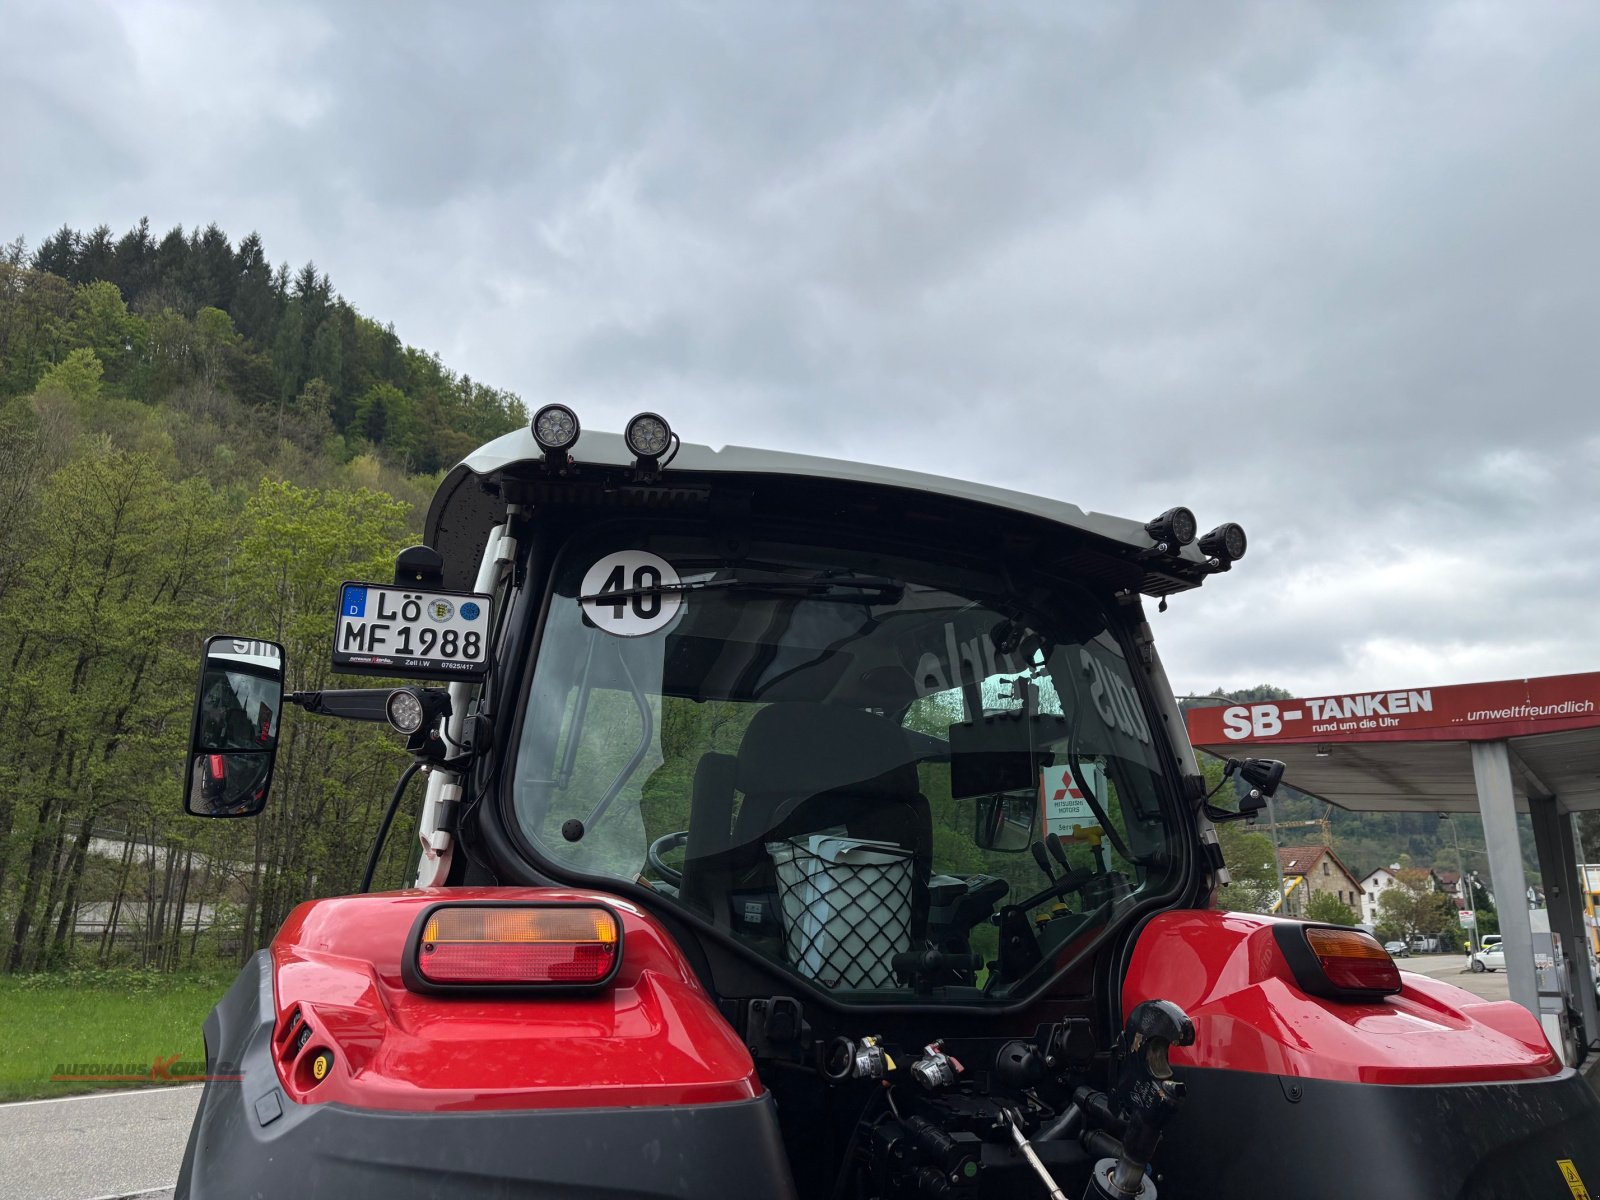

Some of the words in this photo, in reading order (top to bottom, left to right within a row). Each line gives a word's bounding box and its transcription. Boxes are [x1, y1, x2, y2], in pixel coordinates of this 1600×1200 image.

[595, 565, 661, 620] 40
[350, 606, 358, 615] D
[376, 592, 423, 622] LÖ
[1312, 722, 1337, 733] rund
[1339, 722, 1356, 732] um
[1359, 718, 1376, 729] die
[1379, 717, 1399, 728] Uhr
[1054, 800, 1083, 808] MITSUBISHI
